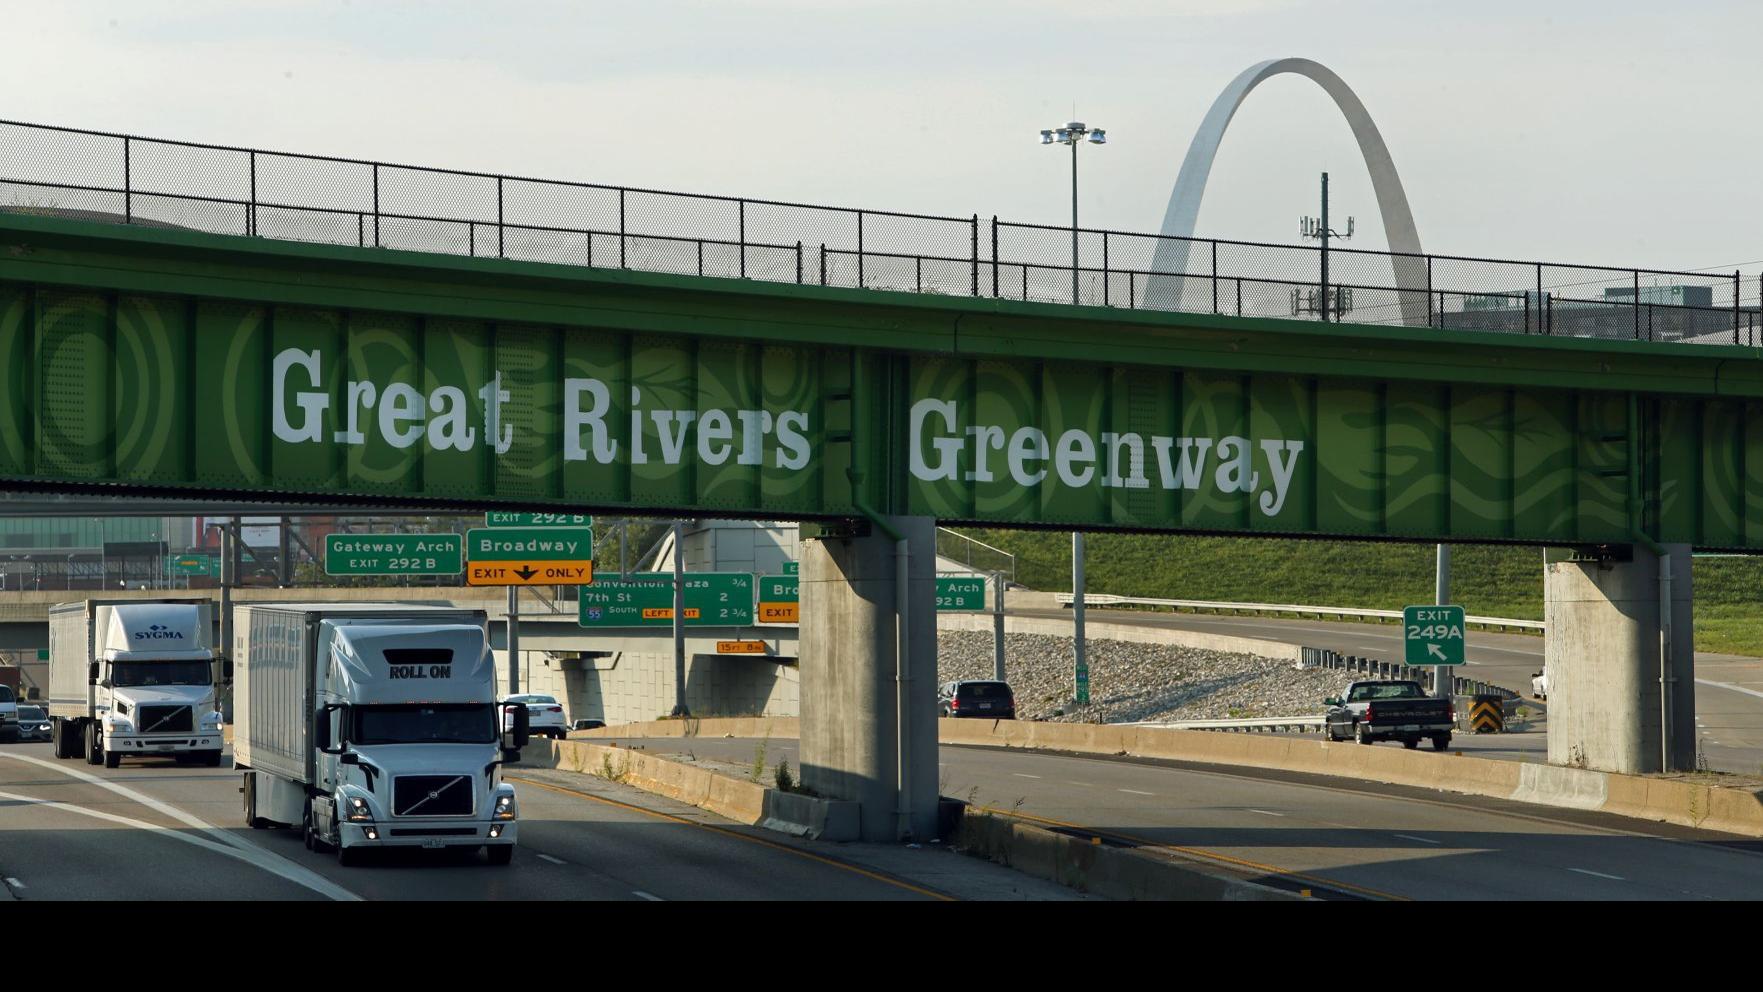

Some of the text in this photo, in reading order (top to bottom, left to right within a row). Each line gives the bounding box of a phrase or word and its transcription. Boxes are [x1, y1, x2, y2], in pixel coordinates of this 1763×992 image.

[273, 347, 1304, 516] Great Rivers Greenway
[493, 513, 520, 522] EXIT
[333, 541, 454, 554] Gateway Arch
[480, 539, 578, 554] Broadway
[349, 559, 379, 568] EXIT
[388, 558, 421, 569] 292
[474, 568, 585, 578] EXIT ONLY
[948, 583, 979, 592] Arch
[586, 592, 728, 602] 7th St 2
[588, 610, 601, 619] 55
[645, 608, 669, 616] LEFT
[719, 608, 728, 617] 2
[766, 608, 793, 617] EXIT
[1417, 610, 1451, 621] EXIT
[135, 631, 183, 640] SYGMA
[1407, 625, 1463, 640] 249A
[389, 665, 451, 680] ROLL ON
[1377, 710, 1443, 718] CHEVROLET
